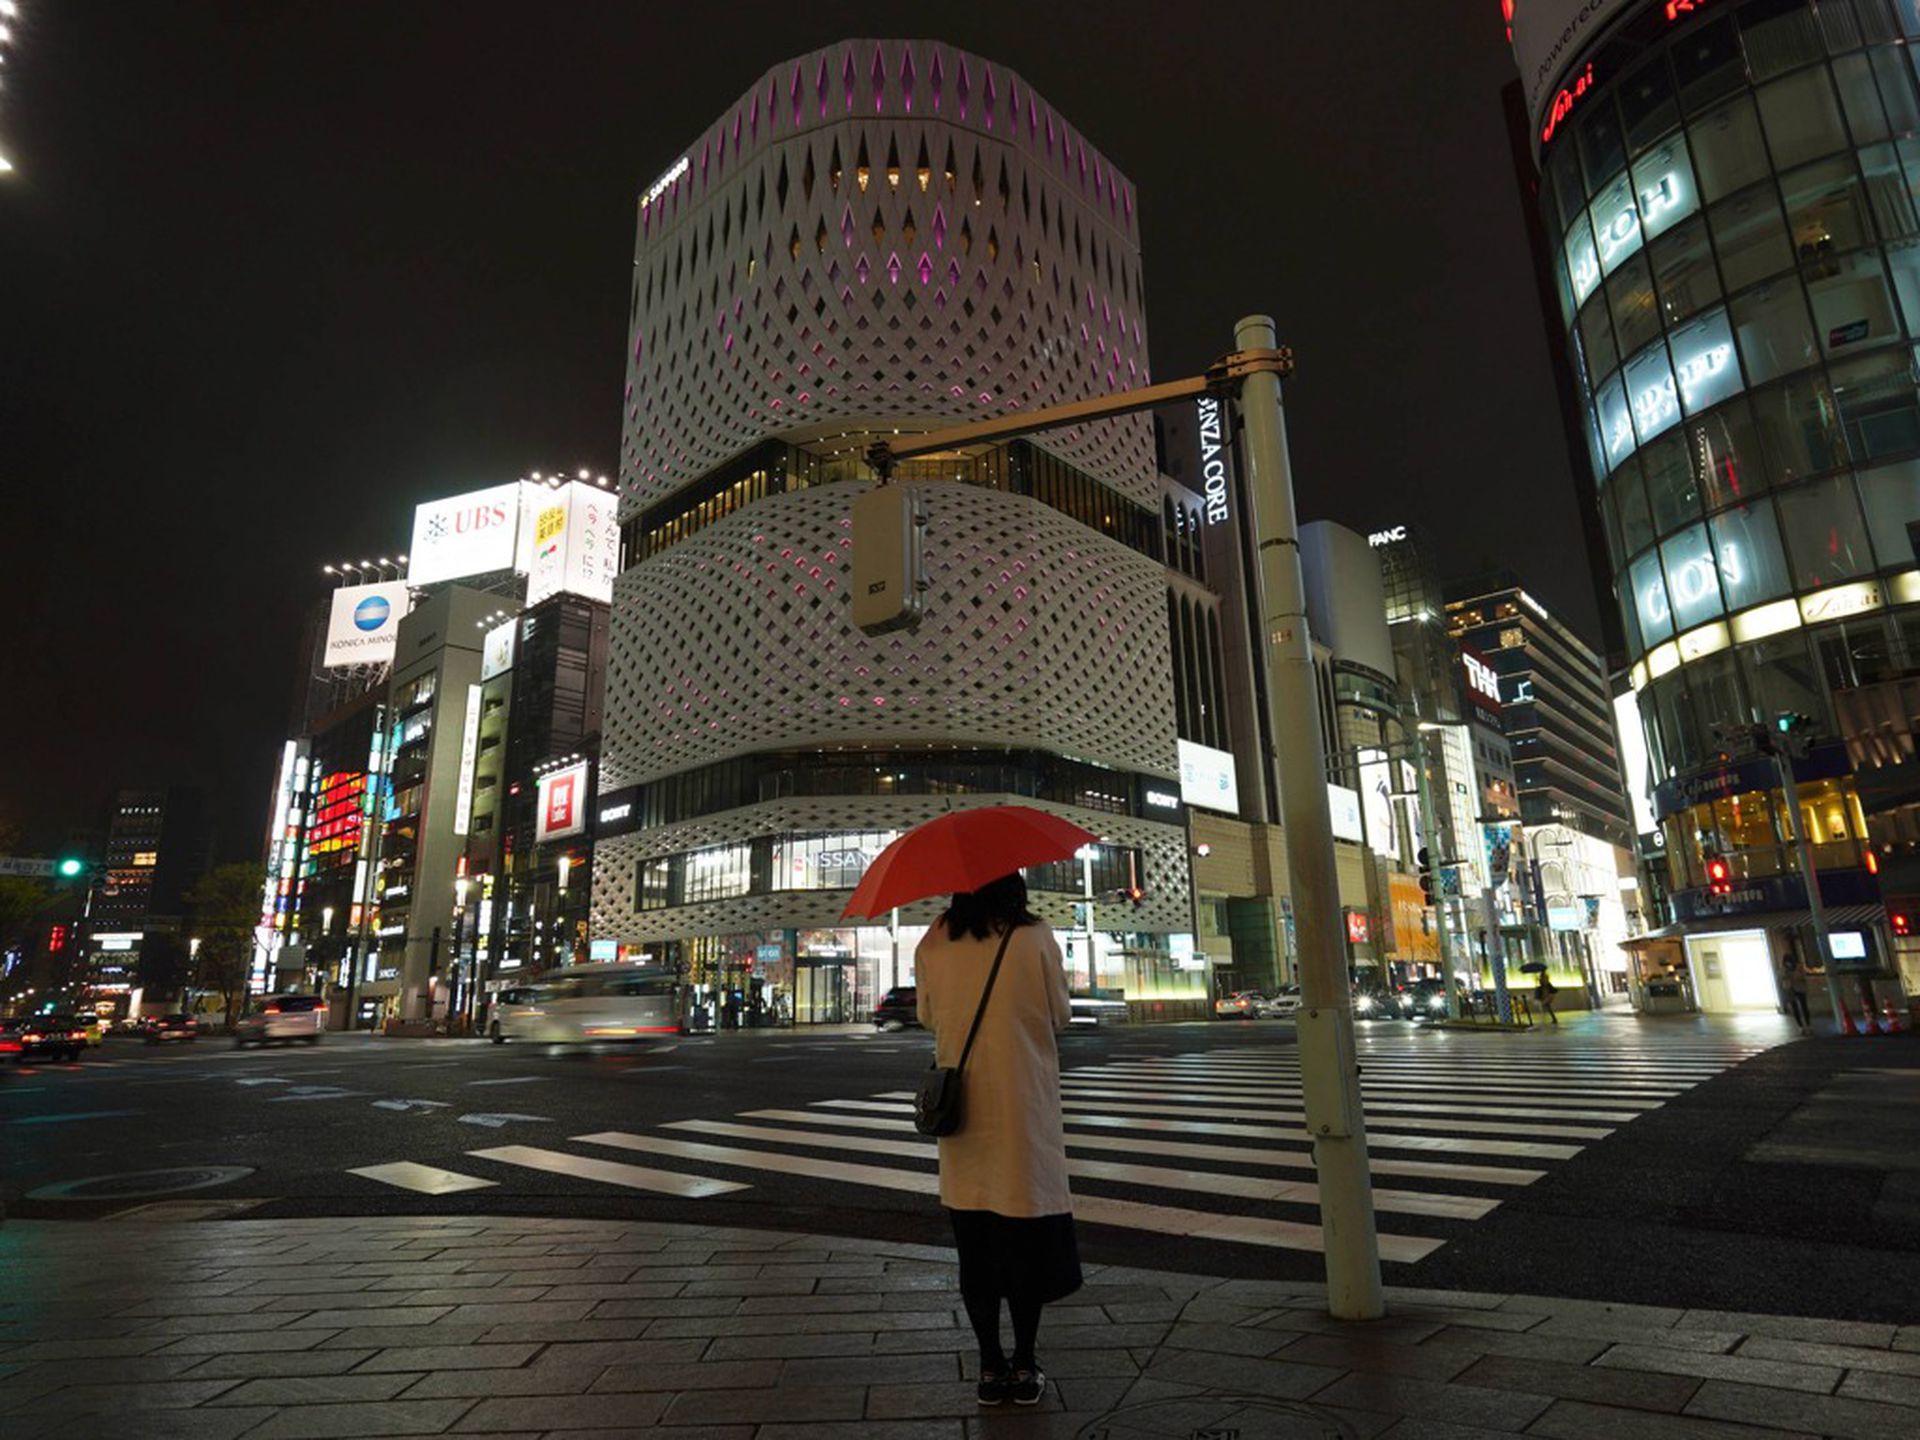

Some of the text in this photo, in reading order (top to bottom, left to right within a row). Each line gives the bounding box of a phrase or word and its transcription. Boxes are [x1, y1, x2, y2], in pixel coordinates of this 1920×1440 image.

[1198, 397, 1230, 527] INZA CORE
[455, 502, 506, 534] UBS
[330, 633, 397, 650] KONICA MINO
